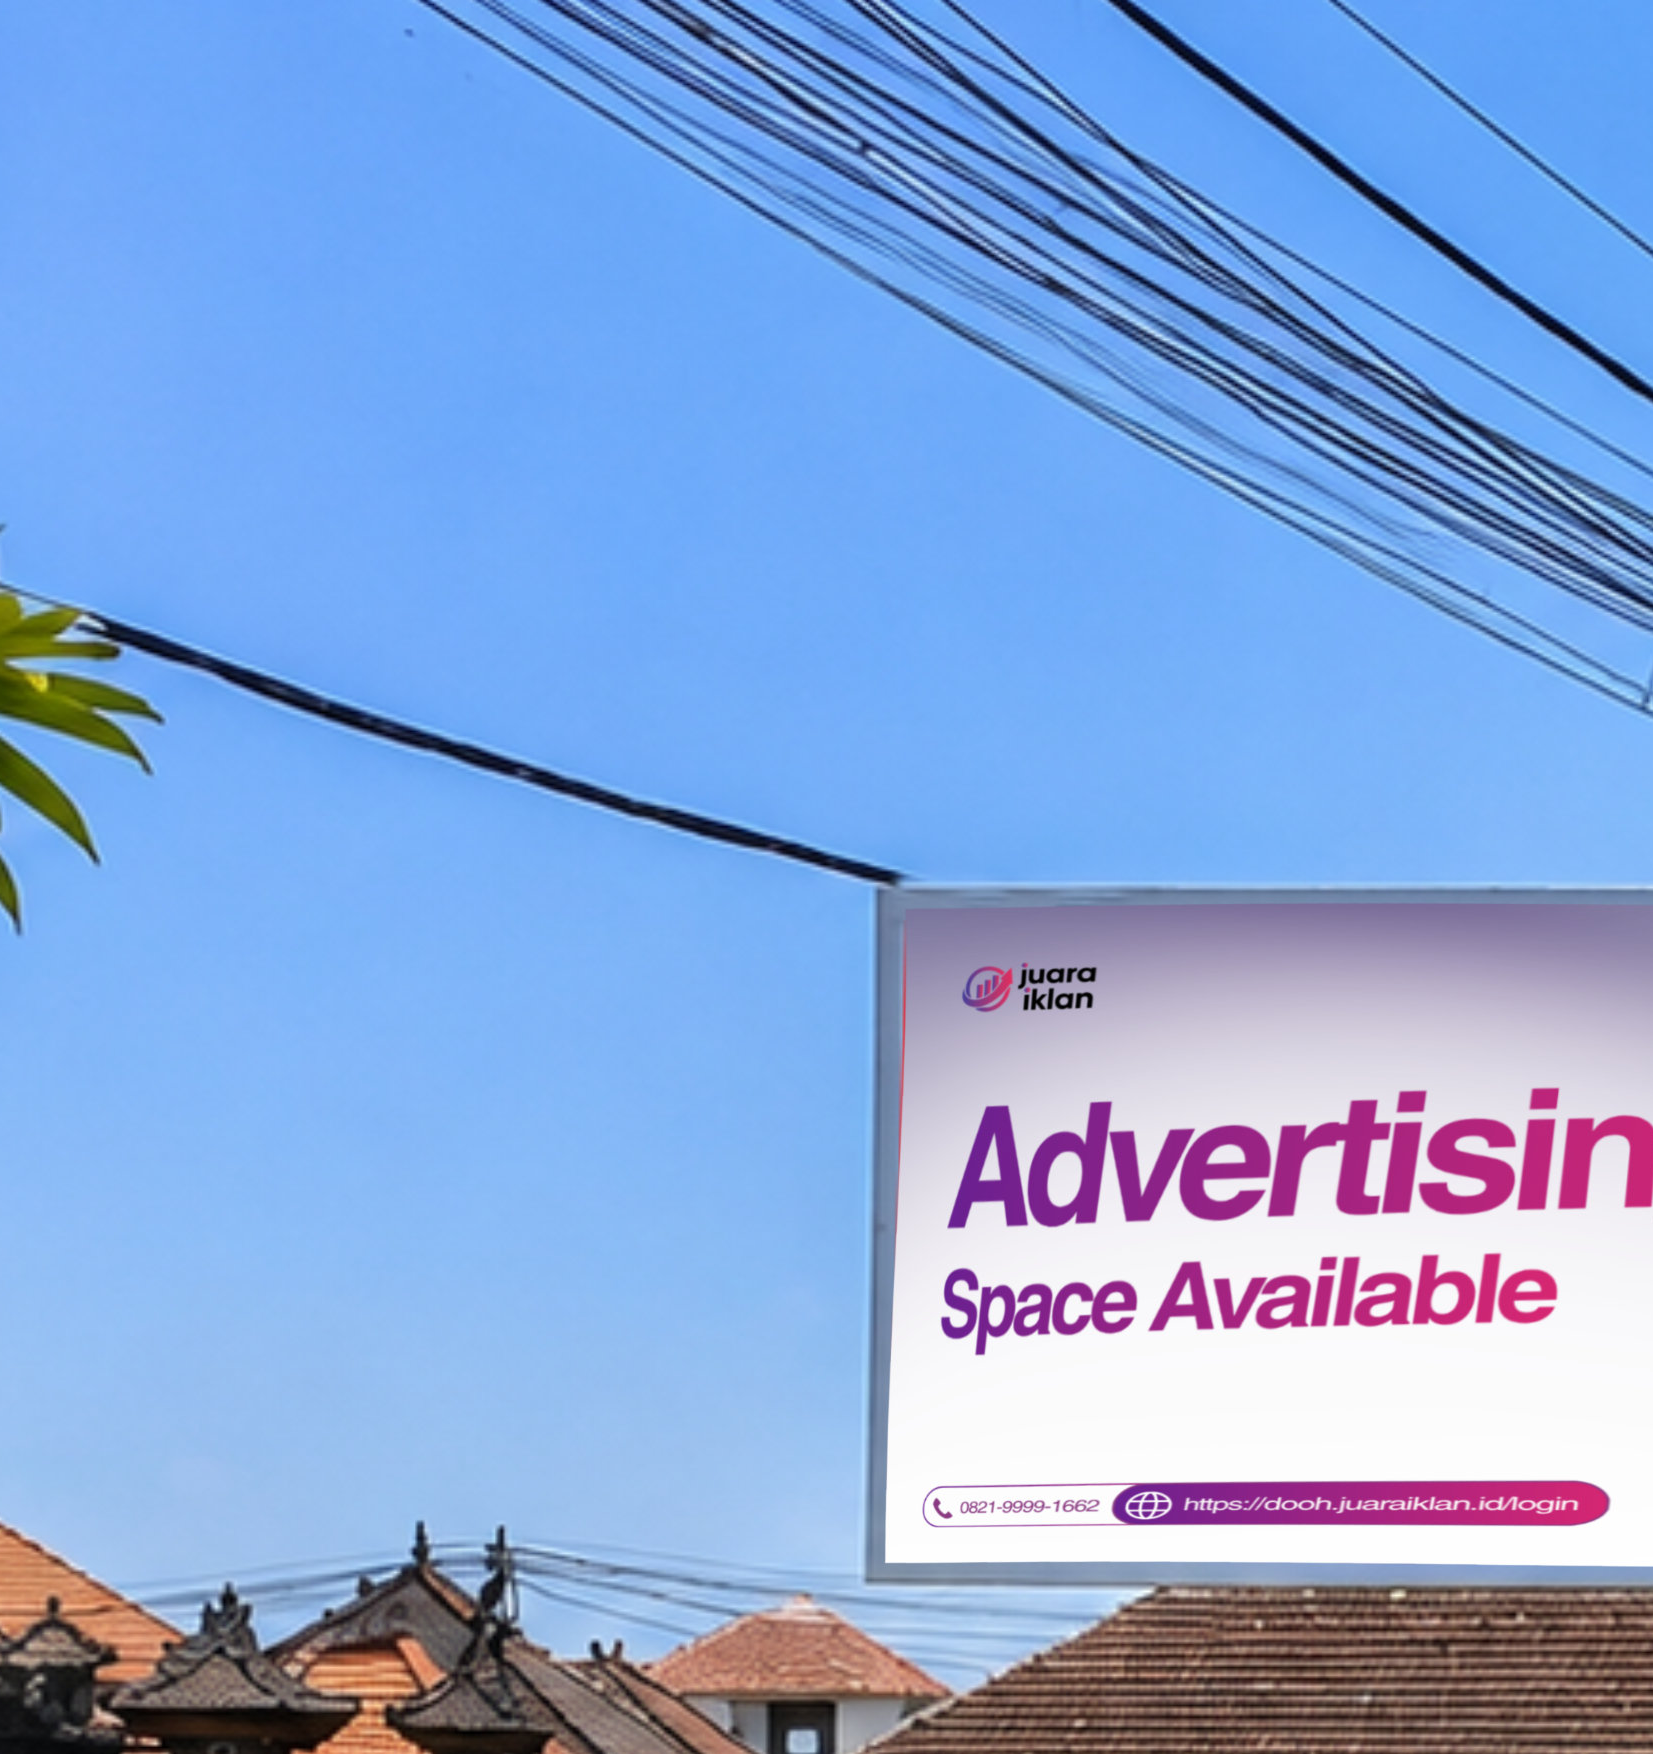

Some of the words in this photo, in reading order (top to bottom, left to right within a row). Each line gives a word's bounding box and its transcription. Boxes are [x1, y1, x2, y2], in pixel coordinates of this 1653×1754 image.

[1018, 963, 1097, 989] juara
[1023, 987, 1094, 1011] iklan
[941, 1267, 1138, 1355] Space
[1149, 1253, 1558, 1332] Available
[959, 1499, 1101, 1514] 0821-9999-1662
[1184, 1496, 1579, 1514] https://dooh.juaraiklan.id/login
